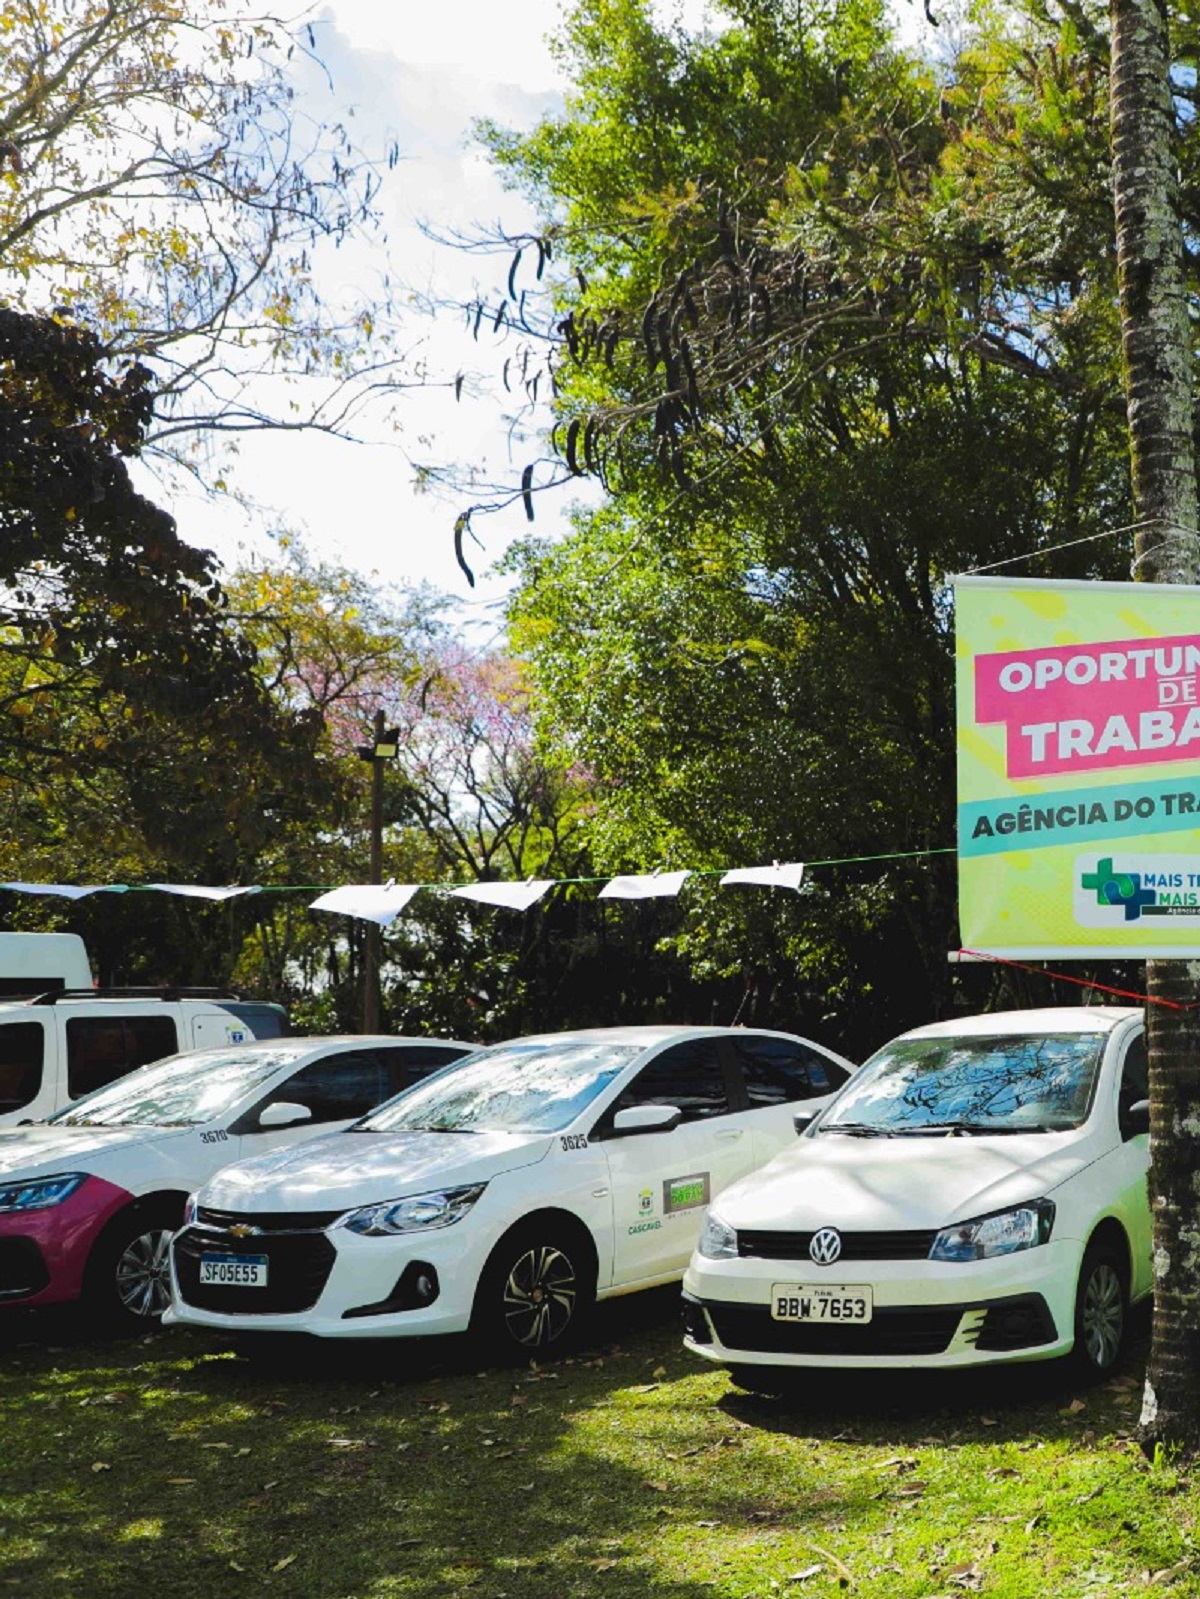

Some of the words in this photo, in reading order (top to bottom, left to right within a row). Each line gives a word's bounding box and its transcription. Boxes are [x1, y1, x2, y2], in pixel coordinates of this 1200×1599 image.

[1159, 679, 1197, 703] DE
[972, 804, 1107, 839] AGÊNCIA
[1114, 796, 1156, 822] DO
[1144, 873, 1183, 888] MAIS
[1159, 892, 1198, 906] MAIS
[560, 1133, 588, 1151] 3625
